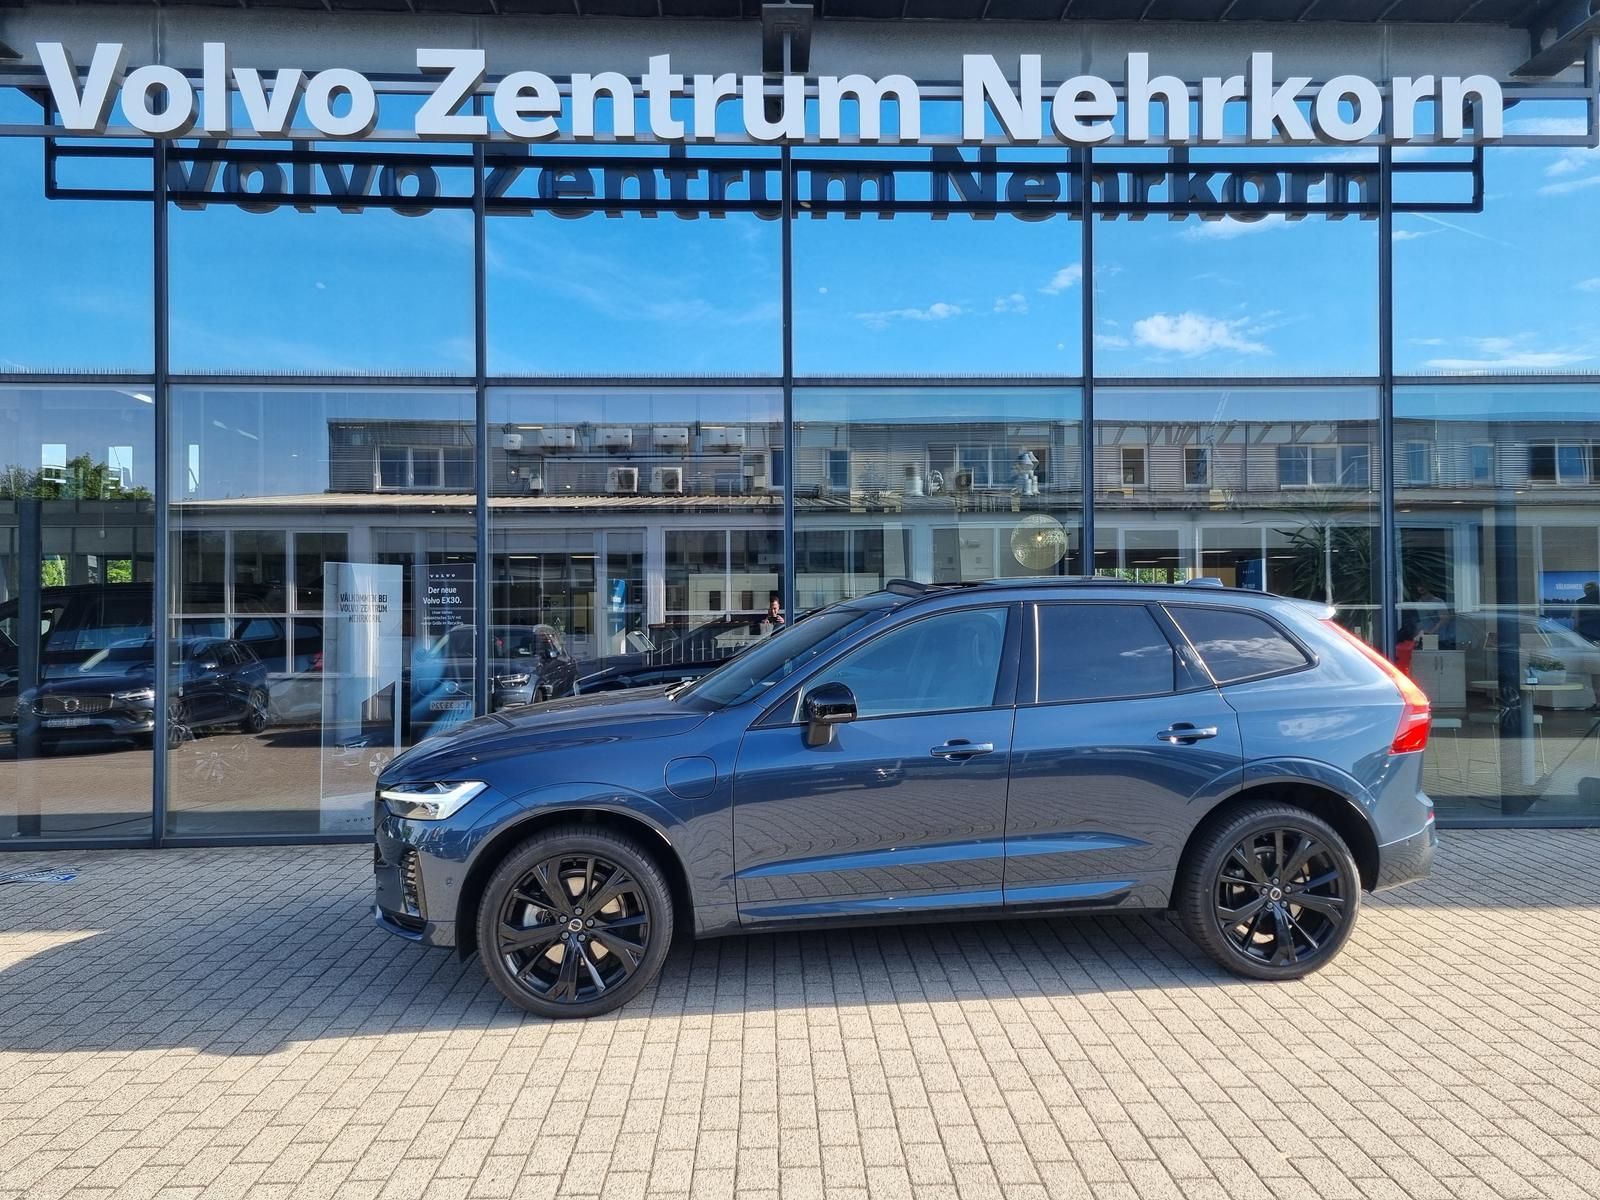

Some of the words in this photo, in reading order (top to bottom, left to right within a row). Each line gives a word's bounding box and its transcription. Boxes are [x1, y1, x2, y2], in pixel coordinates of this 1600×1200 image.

[36, 42, 379, 137] Volvo
[415, 48, 921, 143] Zentrum
[962, 52, 1503, 144] Nehrkorn
[428, 586, 440, 594] Der
[378, 594, 388, 602] BEI
[442, 596, 462, 604] EX30.
[340, 604, 359, 613] VOLVO
[360, 604, 388, 613] ZENTRUM
